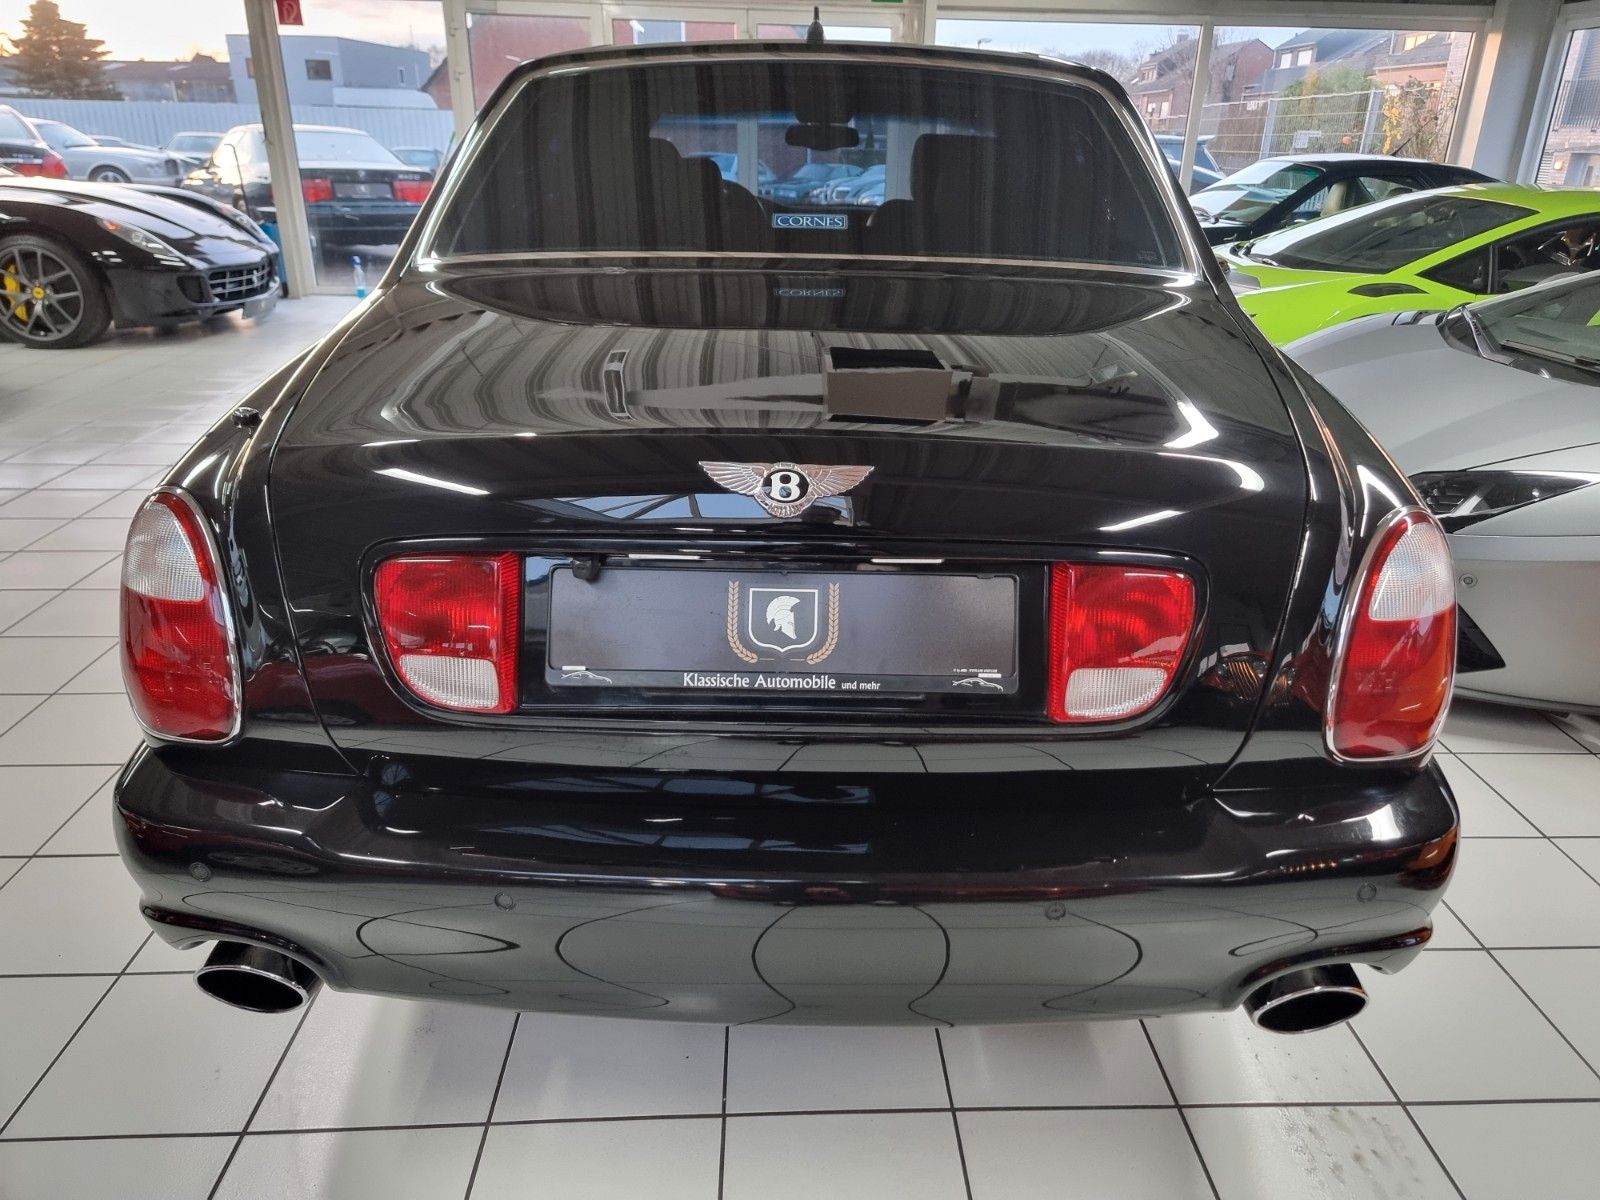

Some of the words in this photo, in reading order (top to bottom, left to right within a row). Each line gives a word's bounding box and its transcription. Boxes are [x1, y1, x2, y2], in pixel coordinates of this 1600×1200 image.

[777, 216, 843, 227] CORNES
[770, 471, 801, 501] B
[683, 672, 750, 688] Klassische
[754, 674, 836, 689] Automobile
[841, 681, 857, 690] und
[859, 681, 881, 690] mehr
